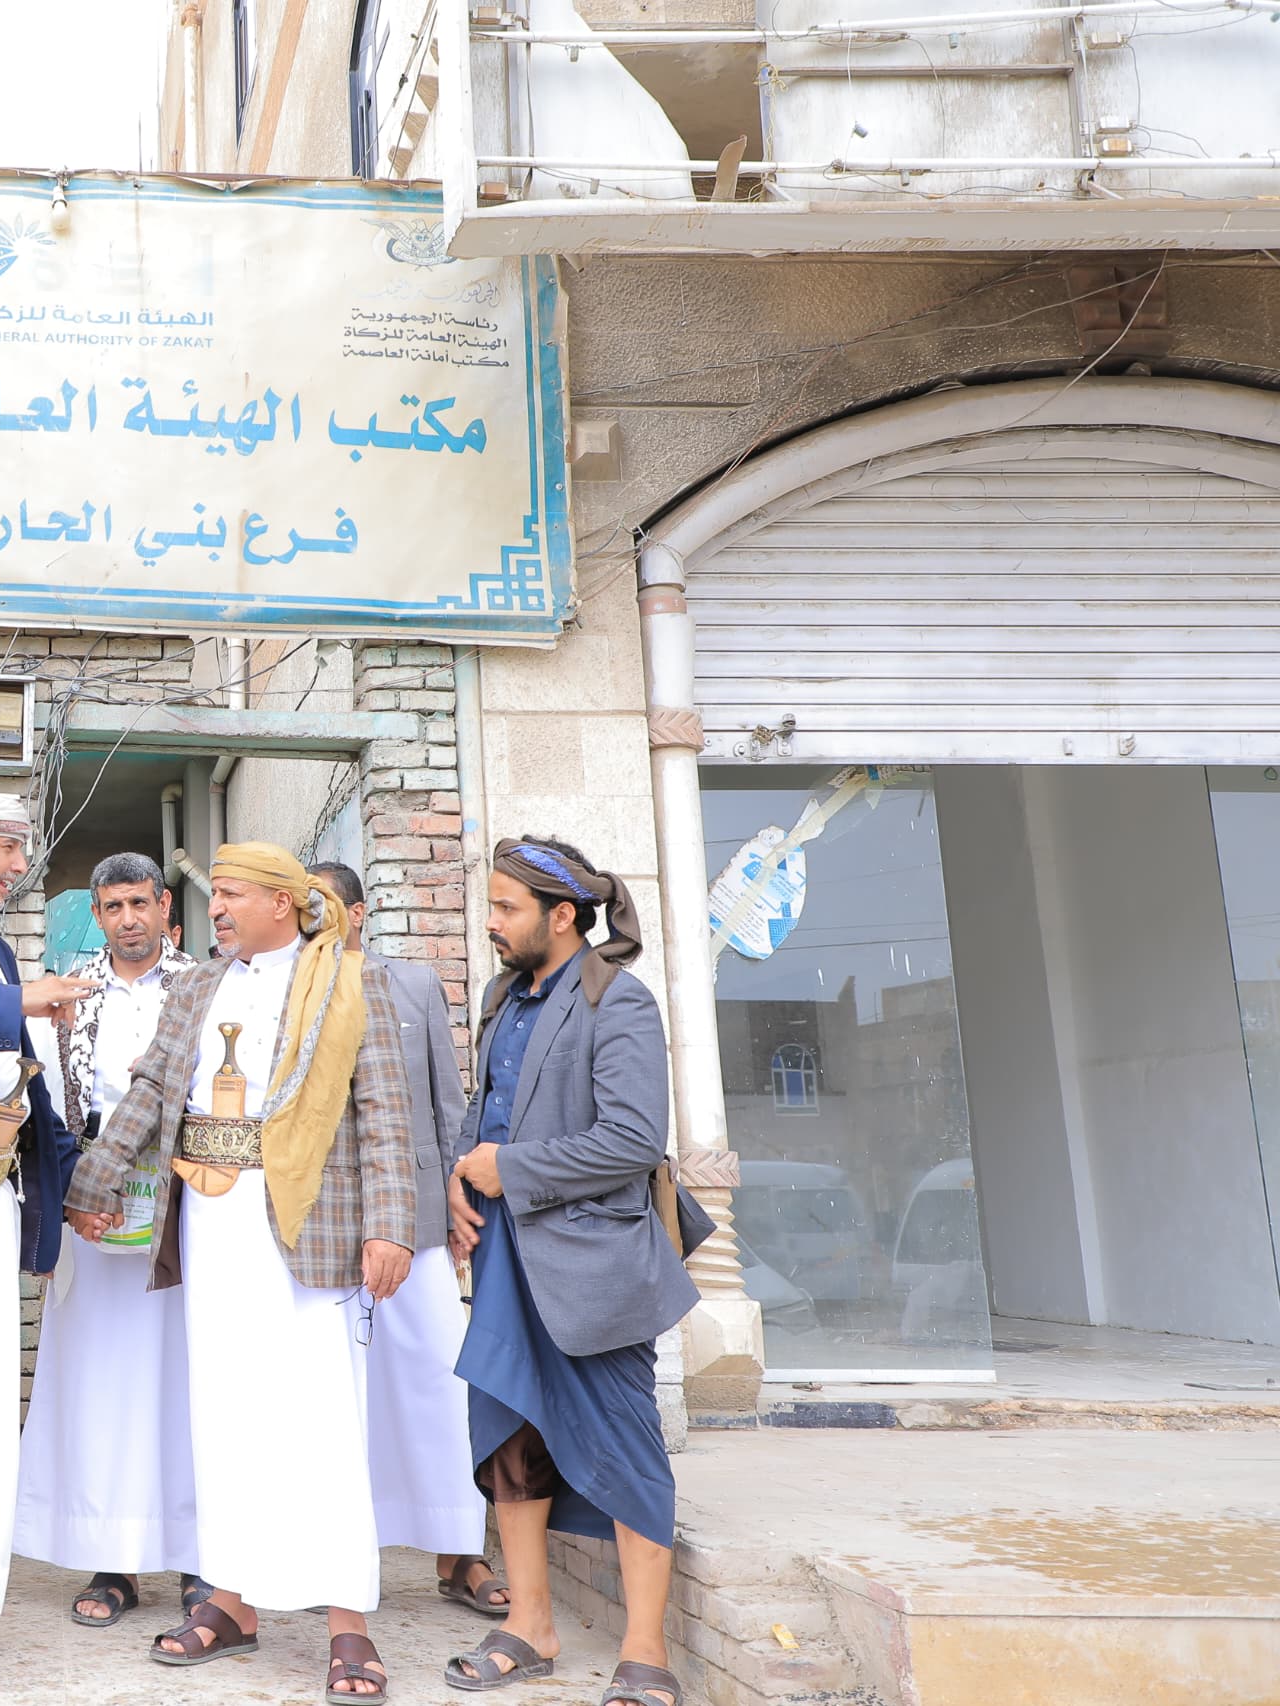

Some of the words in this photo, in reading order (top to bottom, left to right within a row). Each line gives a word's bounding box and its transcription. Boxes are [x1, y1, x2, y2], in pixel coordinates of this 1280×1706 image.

[53, 305, 131, 324] العامة
[137, 308, 214, 328] الهيئة
[351, 307, 442, 326] الجمهورية
[44, 332, 134, 346] AUTHORITY
[138, 335, 159, 347] OF
[162, 336, 214, 349] ZAKAT
[344, 326, 404, 340] للزكاة
[406, 328, 456, 344] العامة
[457, 333, 507, 351] الهيئة
[342, 344, 409, 359] العاصمة
[451, 354, 510, 369] مكتب
[121, 377, 302, 456] الهيئة
[328, 393, 488, 463] مكتب
[133, 502, 227, 567] بني
[241, 506, 358, 566] فرع
